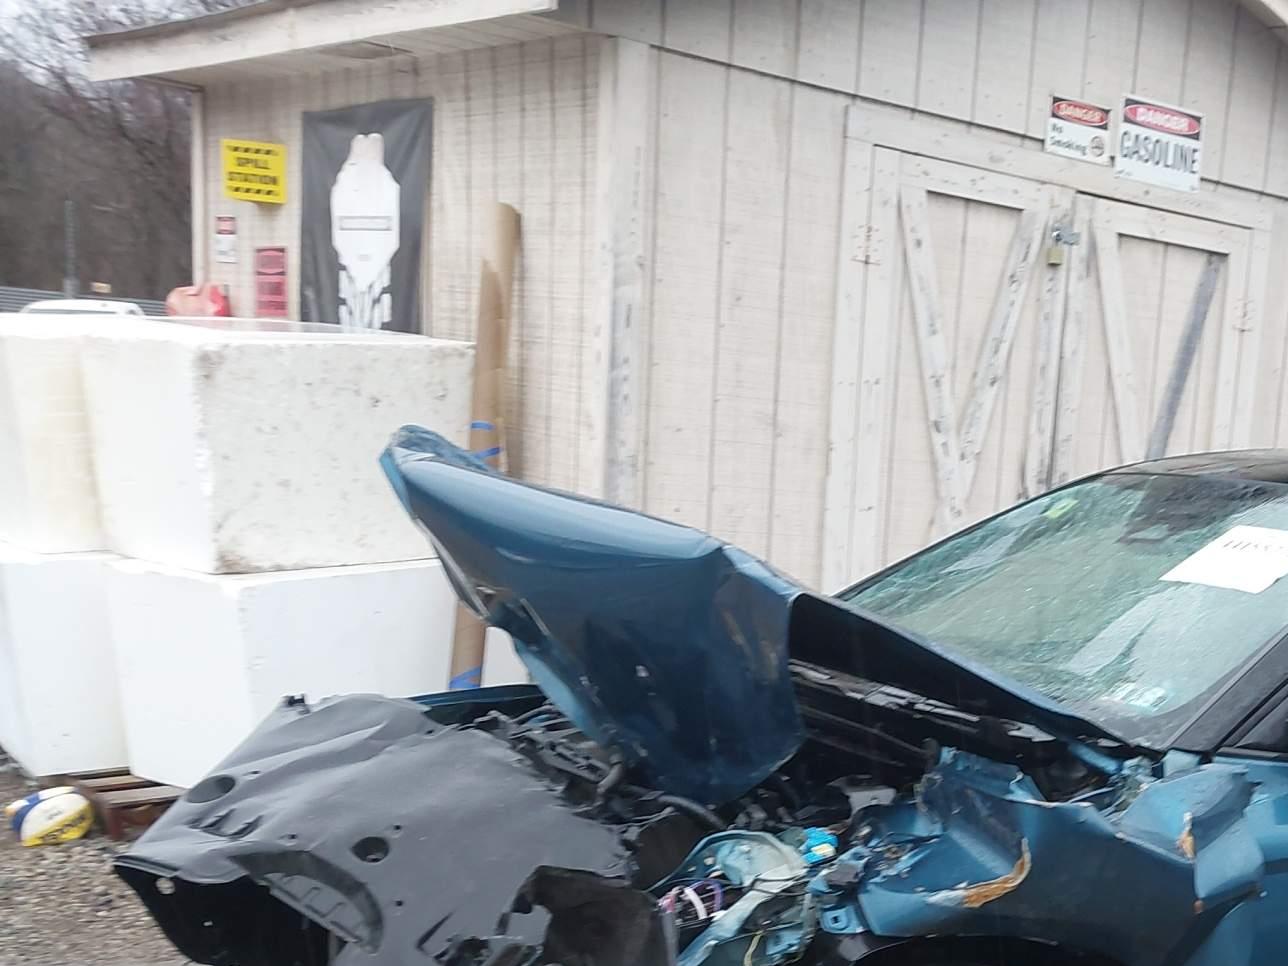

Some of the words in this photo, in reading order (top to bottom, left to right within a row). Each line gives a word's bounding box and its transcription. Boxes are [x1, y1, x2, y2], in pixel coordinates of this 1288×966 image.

[1057, 103, 1104, 123] DANGER
[1135, 106, 1190, 132] DANGER
[1120, 130, 1199, 174] GASOLINE
[235, 156, 271, 170] SPILL
[227, 171, 280, 186] STATION
